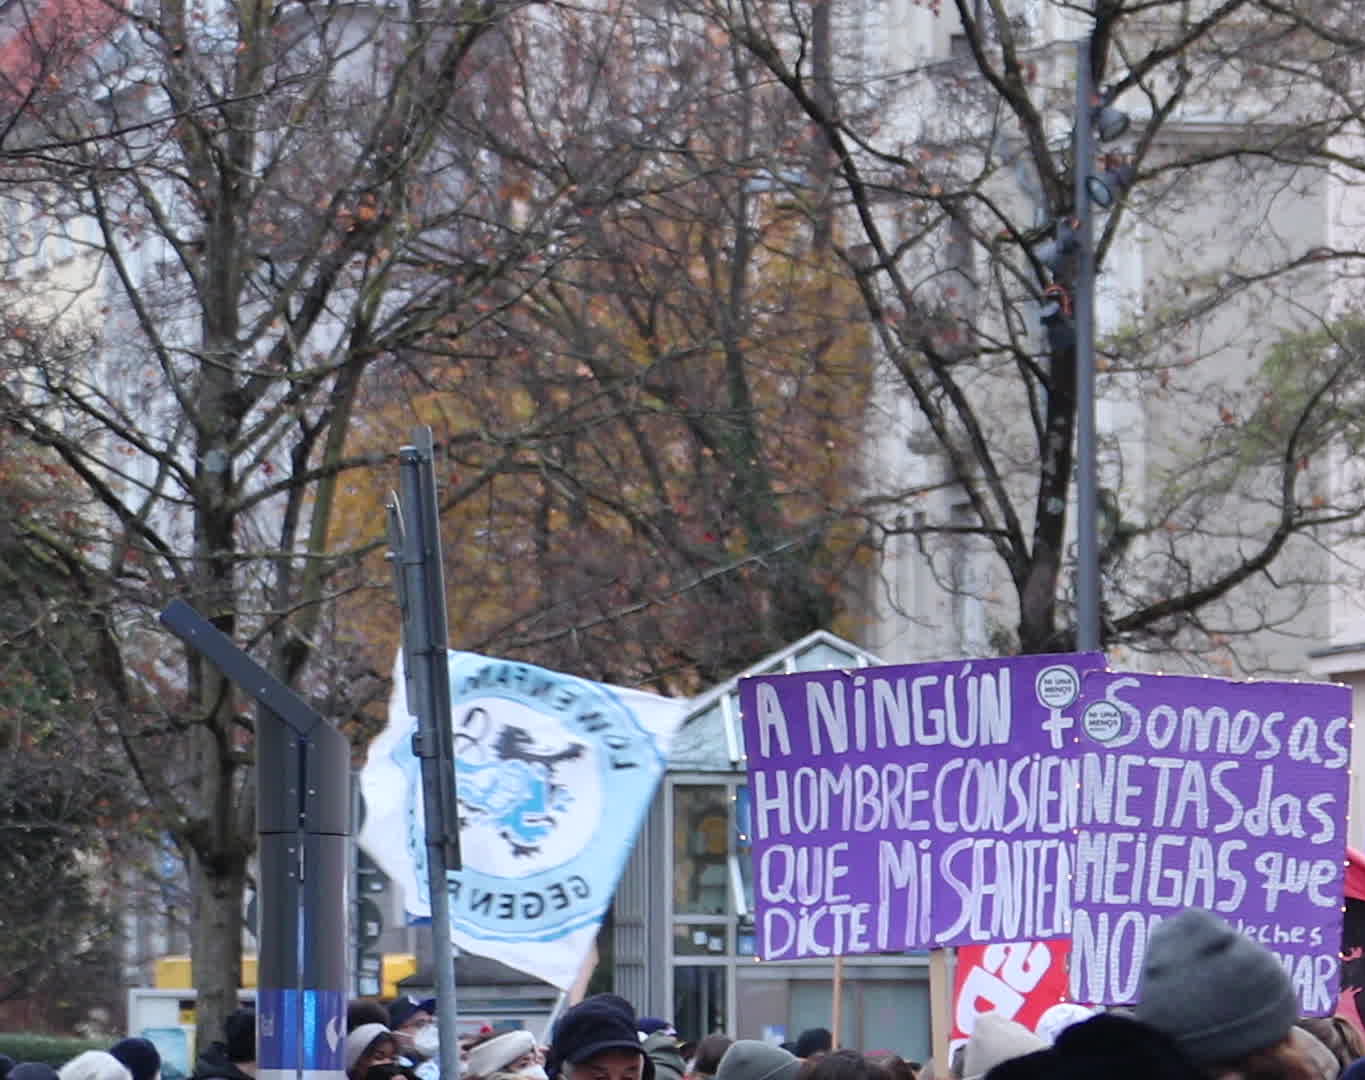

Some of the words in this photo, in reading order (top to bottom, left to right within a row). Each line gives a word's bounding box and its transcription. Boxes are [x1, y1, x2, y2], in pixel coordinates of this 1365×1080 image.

[756, 682, 792, 758] A
[754, 763, 930, 840] HOMBRE
[1081, 752, 1245, 834] NETAS
[1243, 765, 1337, 844] das
[759, 842, 851, 905] QUE
[1253, 851, 1339, 912] que
[1069, 908, 1164, 1004] NO
